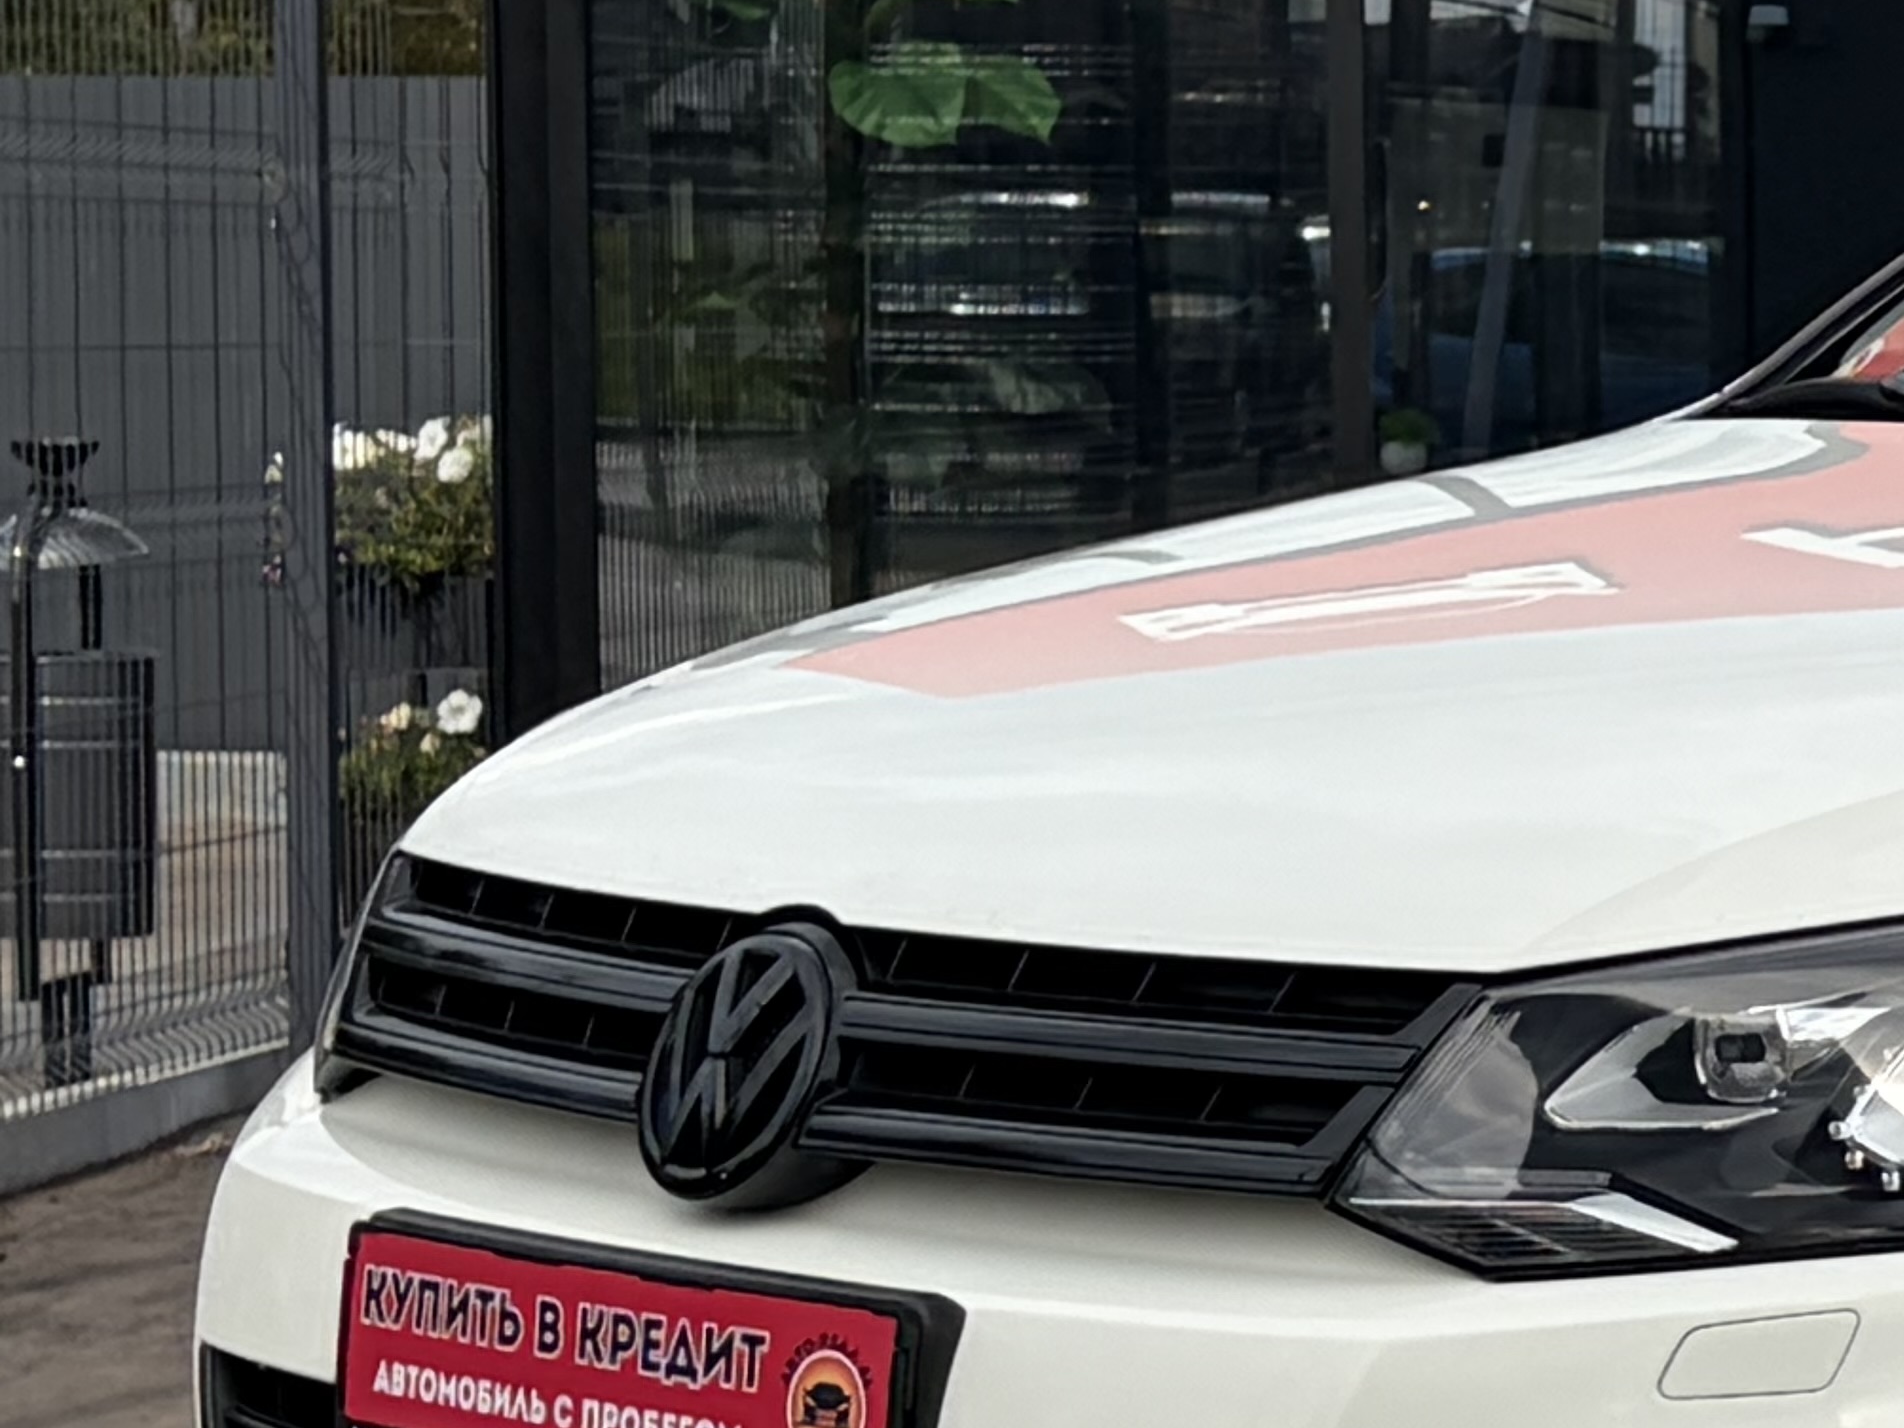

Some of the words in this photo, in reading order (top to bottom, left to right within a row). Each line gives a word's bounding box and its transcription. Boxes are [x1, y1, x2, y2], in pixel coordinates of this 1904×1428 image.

[361, 1264, 524, 1352] КУПИТЬ
[533, 1294, 565, 1360] В
[574, 1301, 770, 1394] КРЕДИТ
[372, 1359, 546, 1425] АВТОМОБИЛЬ
